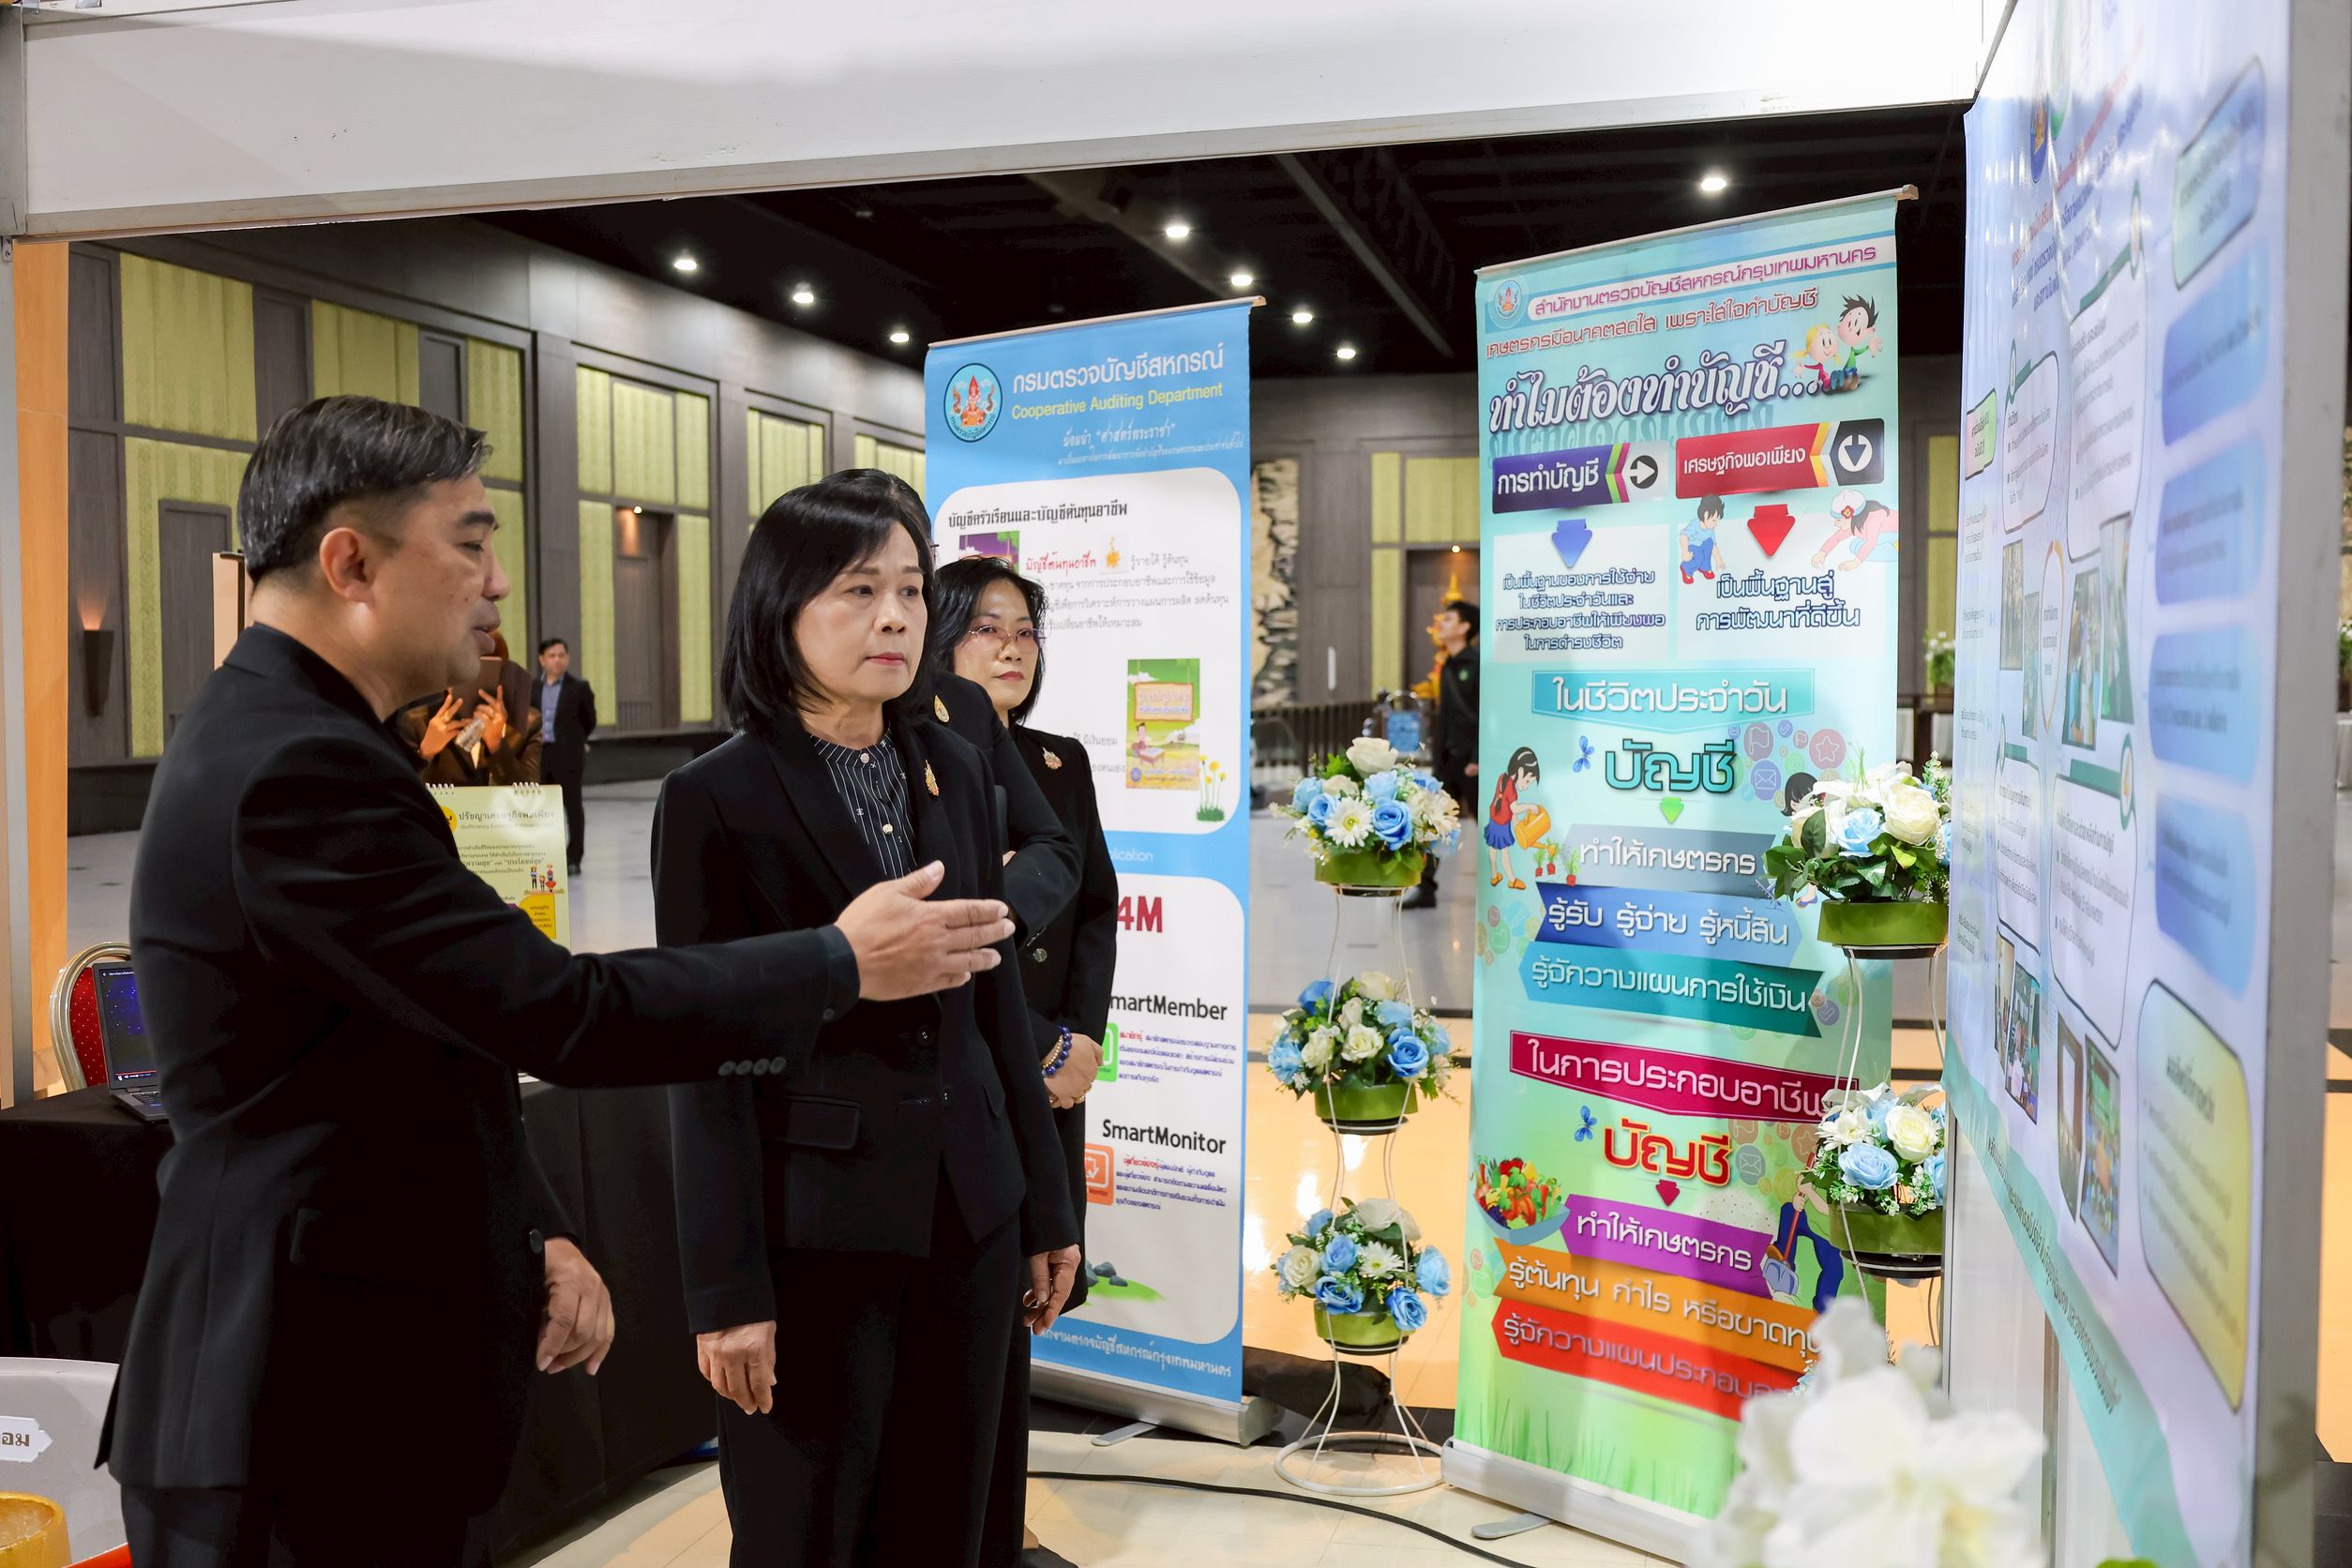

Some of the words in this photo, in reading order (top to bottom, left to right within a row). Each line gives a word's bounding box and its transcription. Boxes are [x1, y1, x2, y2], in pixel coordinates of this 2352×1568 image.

[1534, 245, 1877, 316] สำนักงานตรวจบัญชีสหกรณ์กรุงเทพมหานคร
[1485, 314, 1657, 359] เกษตรกรมีอนาคตสดใส
[1666, 286, 1818, 331] เพราะใส่ใจทำบัญชี
[1013, 343, 1224, 394] กรมตรวจบัญชีสหกรณ์
[1489, 339, 1818, 434] ทำไมต้องทำบัญชี...
[1012, 398, 1086, 419] Cooperative
[1090, 393, 1144, 412] Auditing
[1148, 382, 1223, 405] Department
[1497, 457, 1600, 496] การทำบัญชี
[1683, 444, 1806, 475] เศรษฐกิจพอเพียง
[948, 499, 1127, 530] บัญชีครัวเรือนและบัญชีต้นทุนอาชีพ
[1502, 567, 1655, 592] เป็นพื้นฐานของการใช้จ่าย
[1716, 569, 1835, 601] เป็นพื้นฐานสู่
[1518, 591, 1634, 610] ในชีวิตประจำวันและ
[1696, 599, 1861, 631] การพัฒนาที่ดีขึ้น
[1495, 611, 1666, 631] การประกอบอาชีพให้เพียงพอ
[1524, 633, 1623, 651] ในการดำรงชีวิต
[1552, 675, 1787, 713] ในชีวิตประจำวัน
[1604, 738, 1737, 793] บัญชี
[1578, 836, 1756, 876] ทำให้เกษตรกร
[1547, 897, 1604, 931] รู้รับ
[1615, 900, 1688, 938] รู้จ่าย
[1698, 907, 1788, 945] รู้หนี้สิน
[1531, 955, 1806, 1014] รู้จักวางแผนการใช้เงิน
[1109, 993, 1228, 1020] martMember
[1102, 1119, 1227, 1153] SmartMonitor
[1604, 1117, 1734, 1187] บัญชี
[1576, 1211, 1753, 1273] ทำให้เกษตรกร
[1509, 1255, 1601, 1301] รู้ต้นทุน
[1612, 1278, 1672, 1313] กำไร
[0, 1432, 30, 1447] อม
